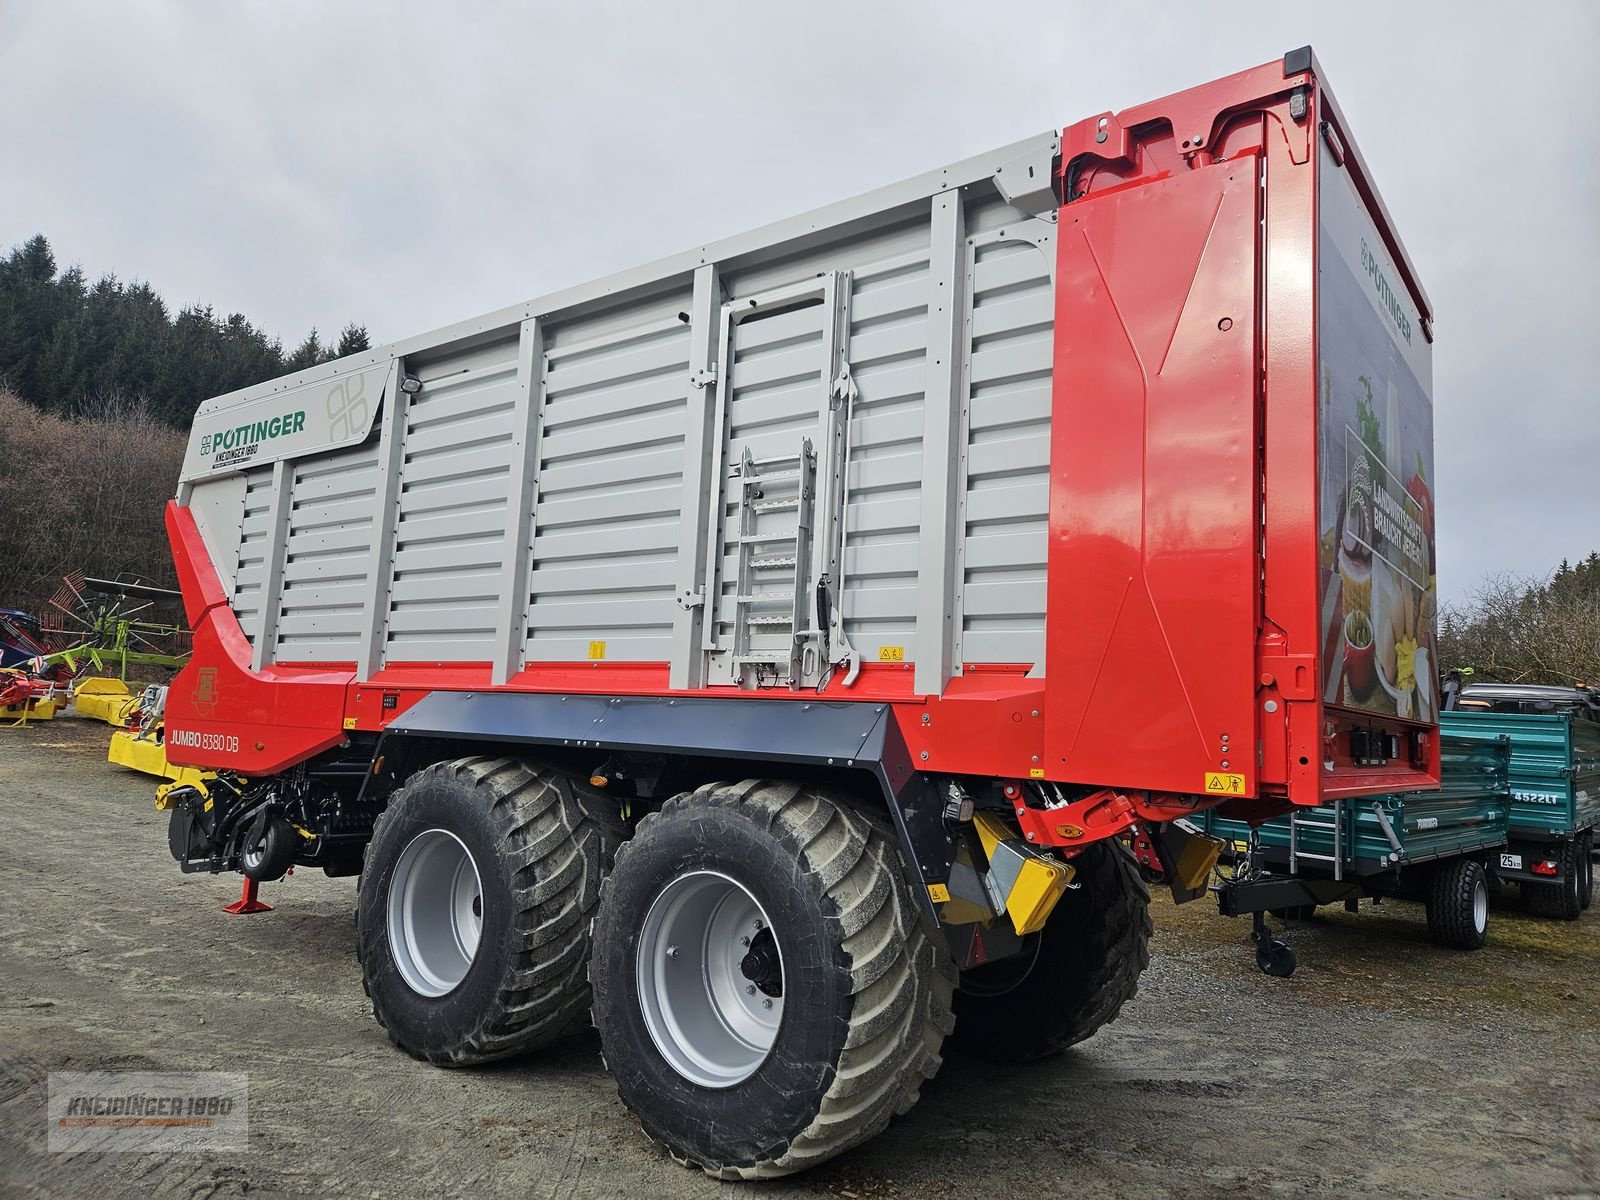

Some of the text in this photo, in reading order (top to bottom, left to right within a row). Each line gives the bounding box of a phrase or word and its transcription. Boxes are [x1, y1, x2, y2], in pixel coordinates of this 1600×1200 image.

[212, 410, 306, 453] PÖTTINGER
[1373, 479, 1422, 545] LANDWIRTSCHAFT
[1373, 506, 1402, 550] BRAUCHT
[170, 729, 239, 753] JUMBO 8380 DB
[1514, 791, 1558, 805] 4522LT
[1501, 855, 1513, 867] 25
